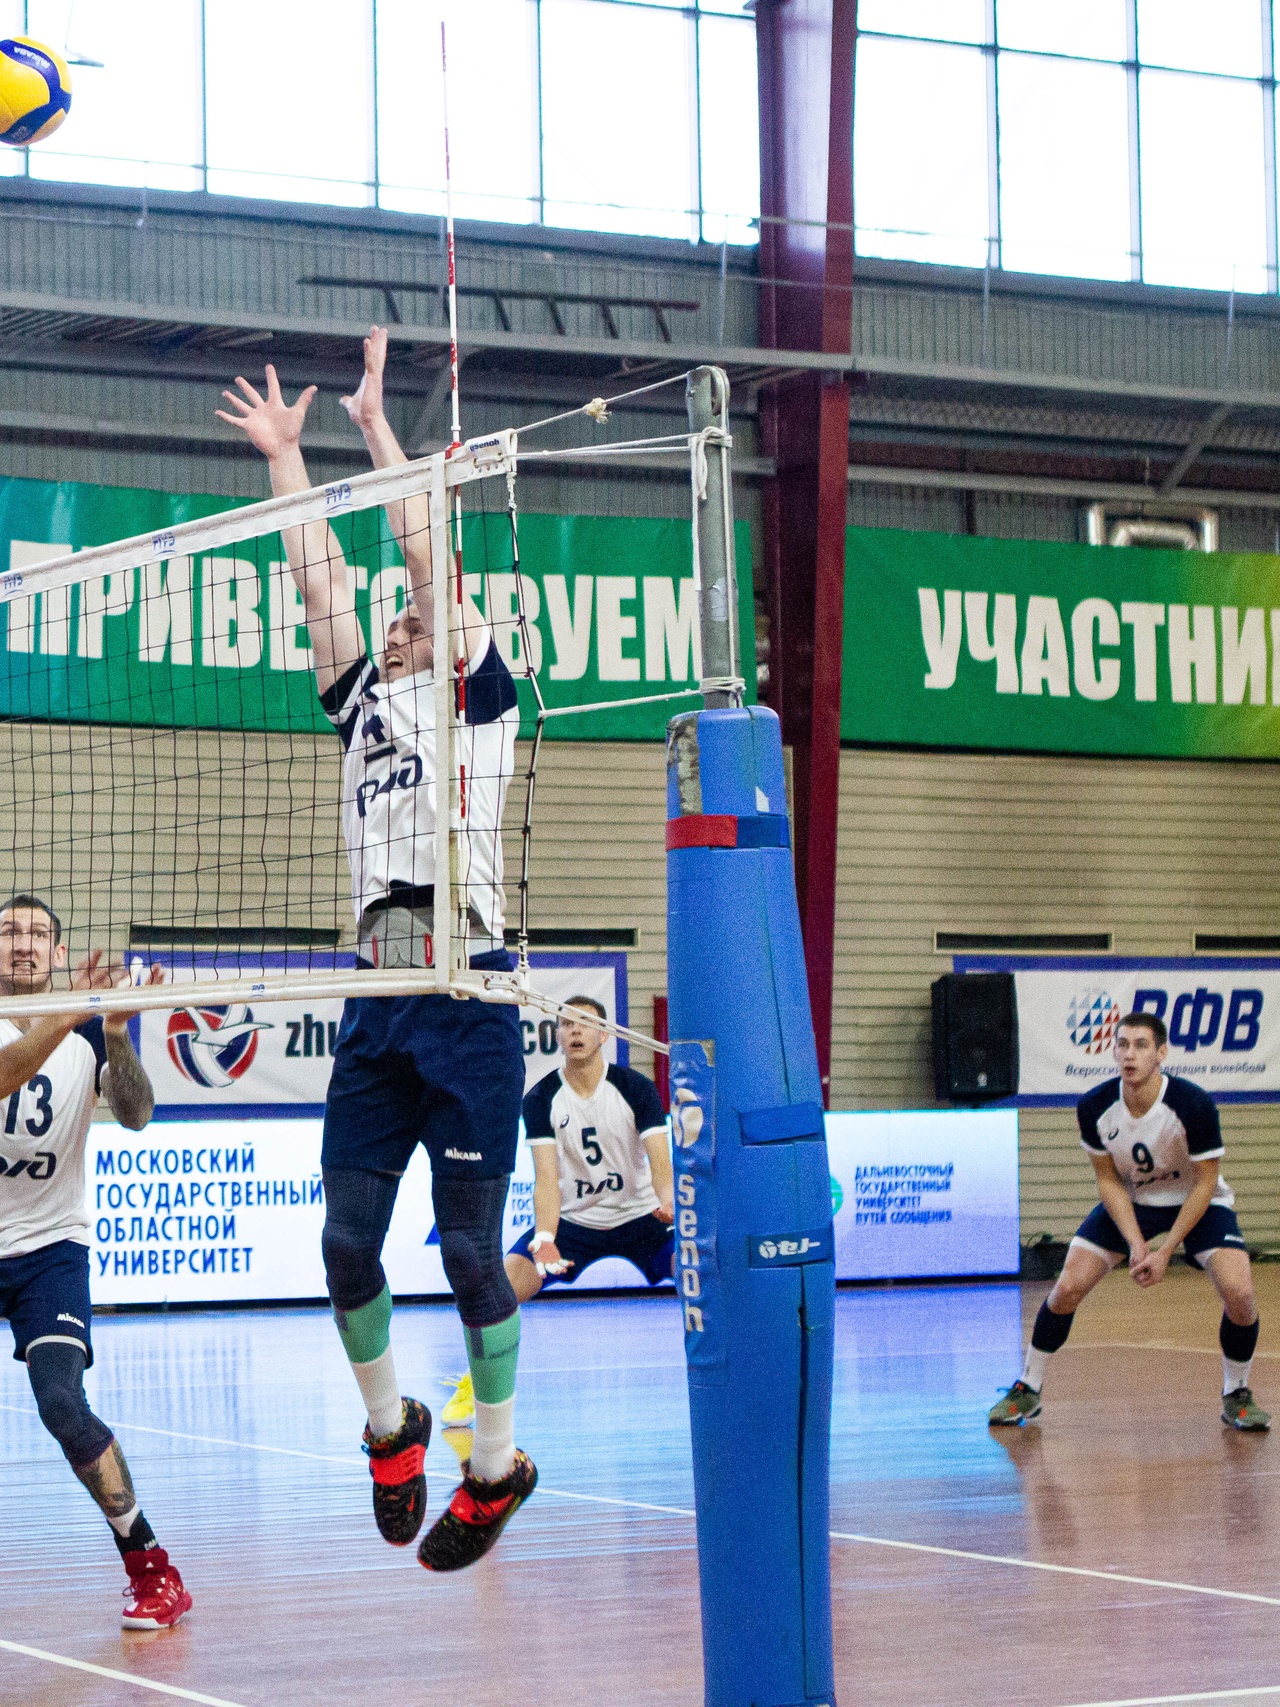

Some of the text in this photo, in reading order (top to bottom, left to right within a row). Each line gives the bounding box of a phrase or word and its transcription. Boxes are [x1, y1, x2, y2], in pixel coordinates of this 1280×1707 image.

[918, 587, 1280, 705] УЧАСТНИ
[4, 1073, 54, 1138] 13
[95, 1141, 255, 1176] МОСКОВСКИЙ
[581, 1126, 603, 1167] 5
[1132, 1141, 1155, 1174] 9
[96, 1173, 323, 1214] ГОСУДАРСТВЕННЫЙ
[96, 1208, 236, 1243] ОБЛАСТНОЙ
[96, 1247, 254, 1277] УНИВЕРСИТЕТ
